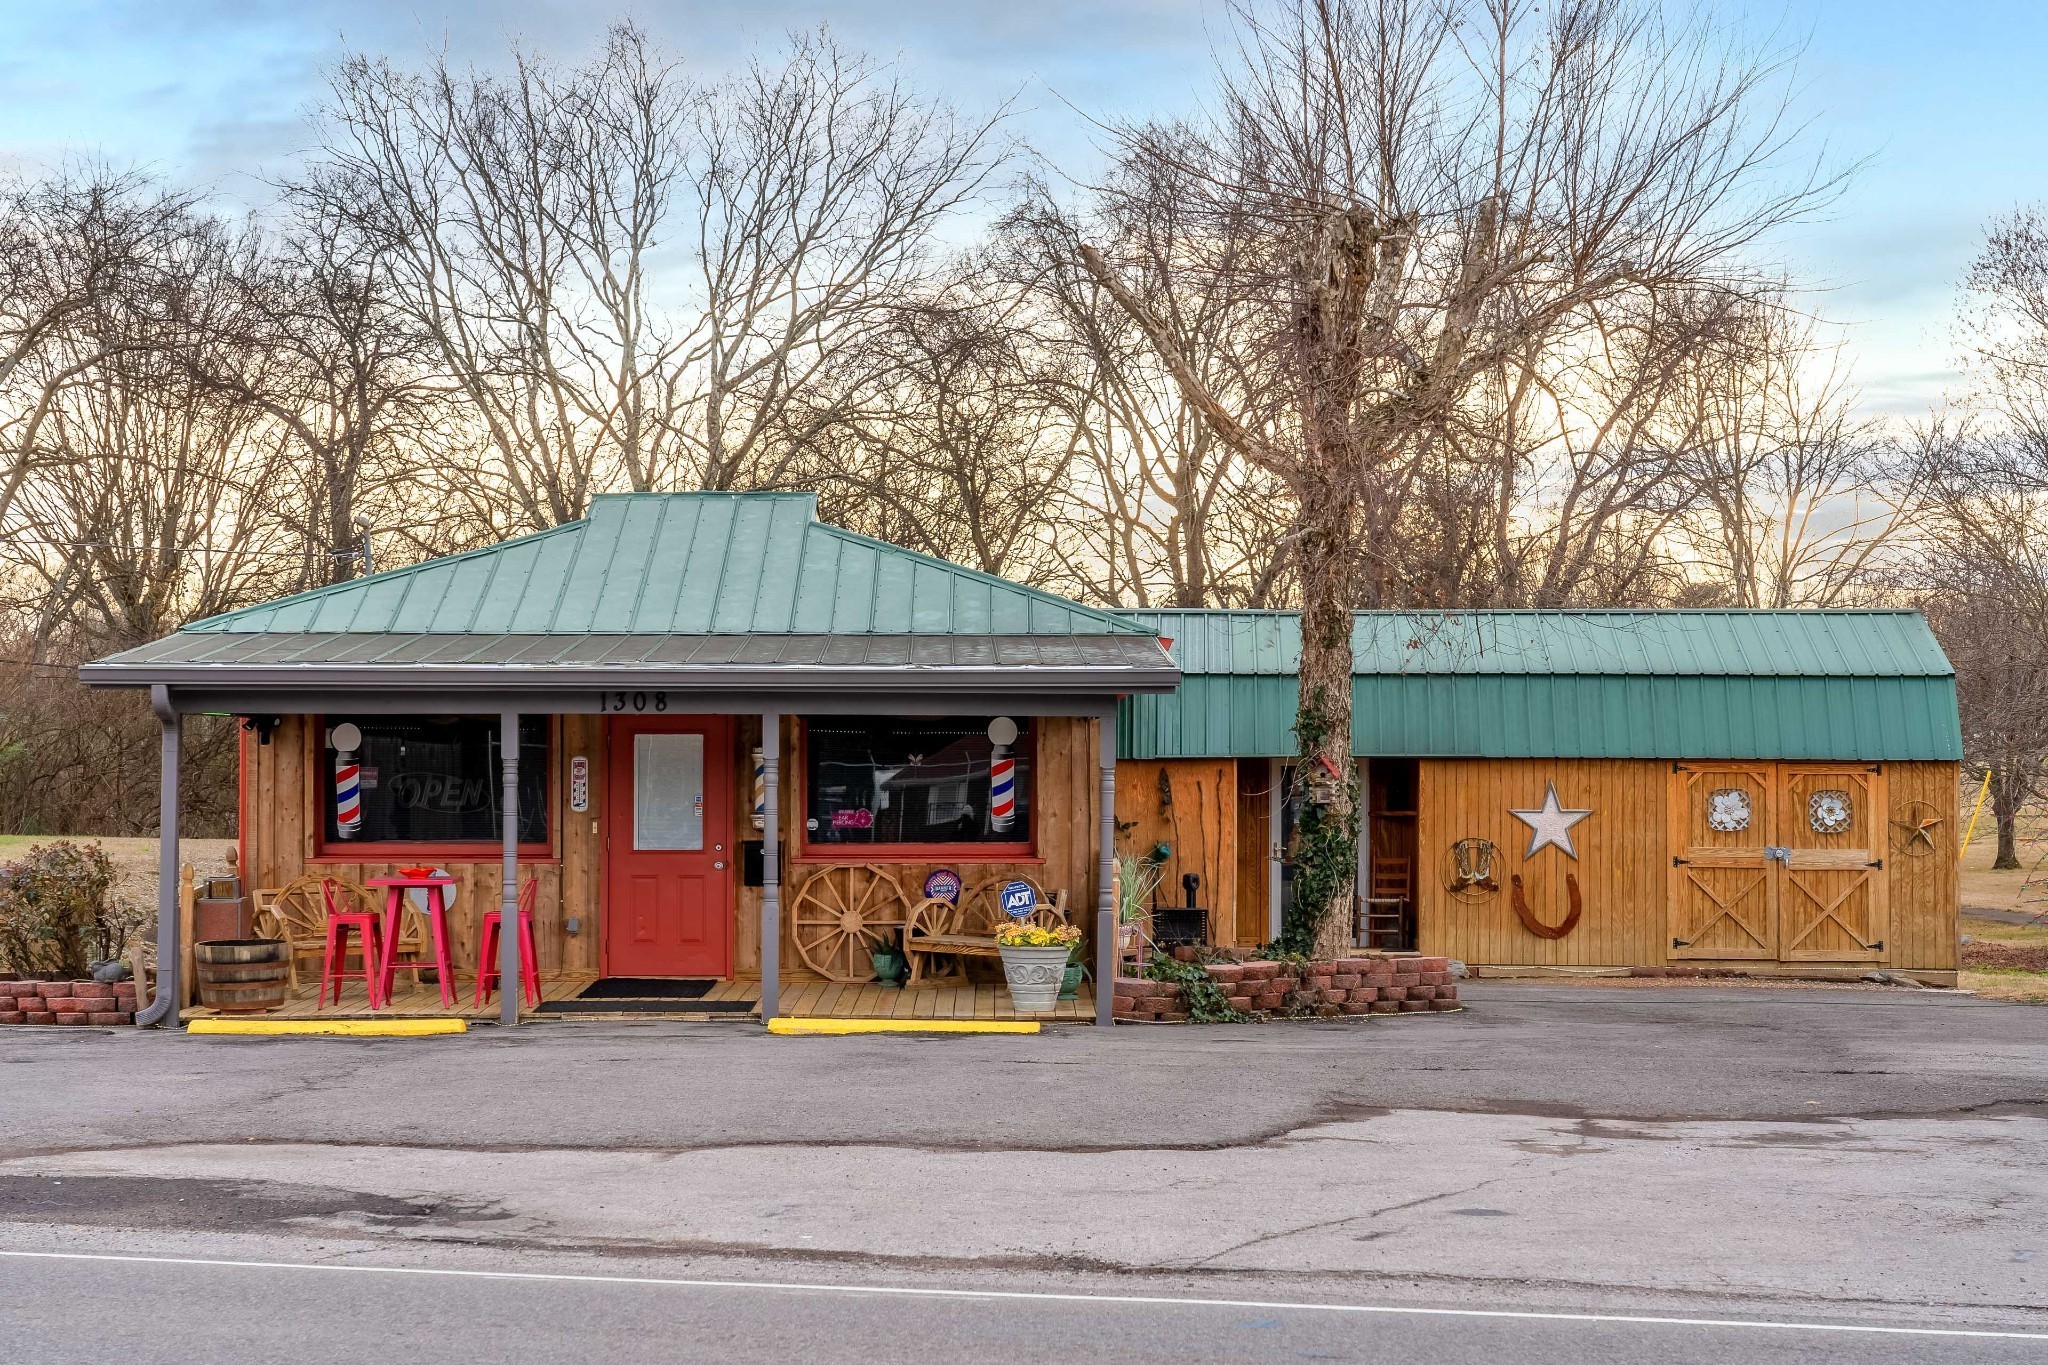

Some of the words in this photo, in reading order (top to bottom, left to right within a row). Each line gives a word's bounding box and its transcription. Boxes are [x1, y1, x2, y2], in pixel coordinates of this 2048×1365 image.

[601, 691, 667, 712] 1308
[400, 776, 483, 808] OPEN
[1007, 891, 1030, 908] ADT
